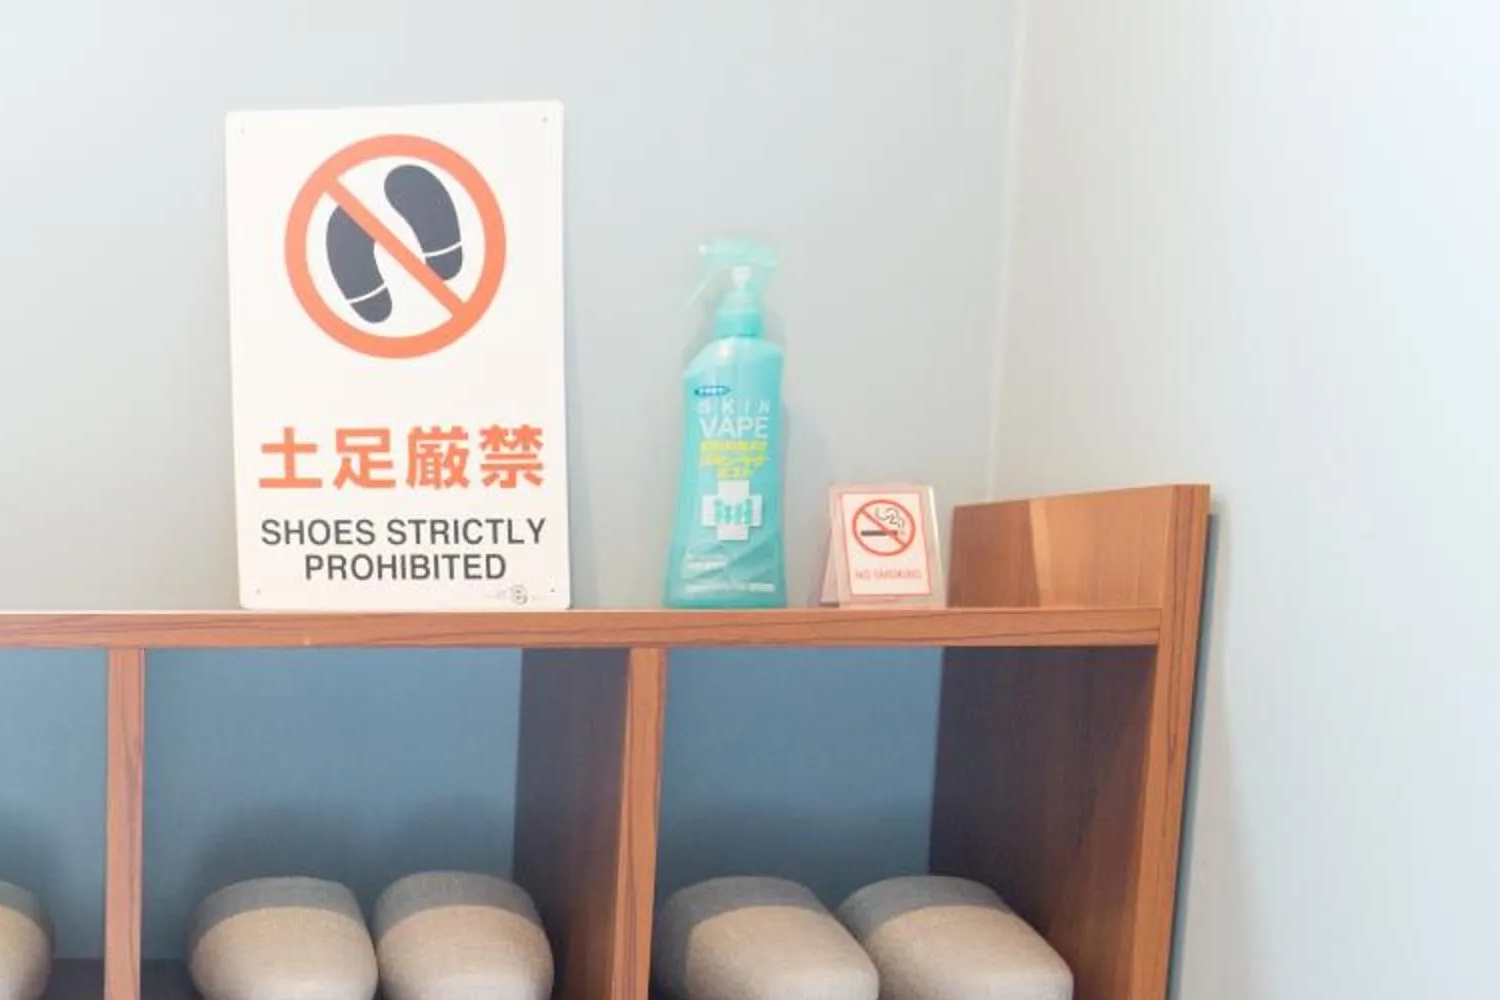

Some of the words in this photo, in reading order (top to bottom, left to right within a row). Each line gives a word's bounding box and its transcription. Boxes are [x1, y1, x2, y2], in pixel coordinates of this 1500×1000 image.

[699, 415, 769, 438] VAPE
[259, 424, 544, 490] 土足厳禁
[260, 518, 376, 546] SHOES
[387, 517, 546, 545] STRICTLY
[305, 553, 507, 581] PROHIBITED
